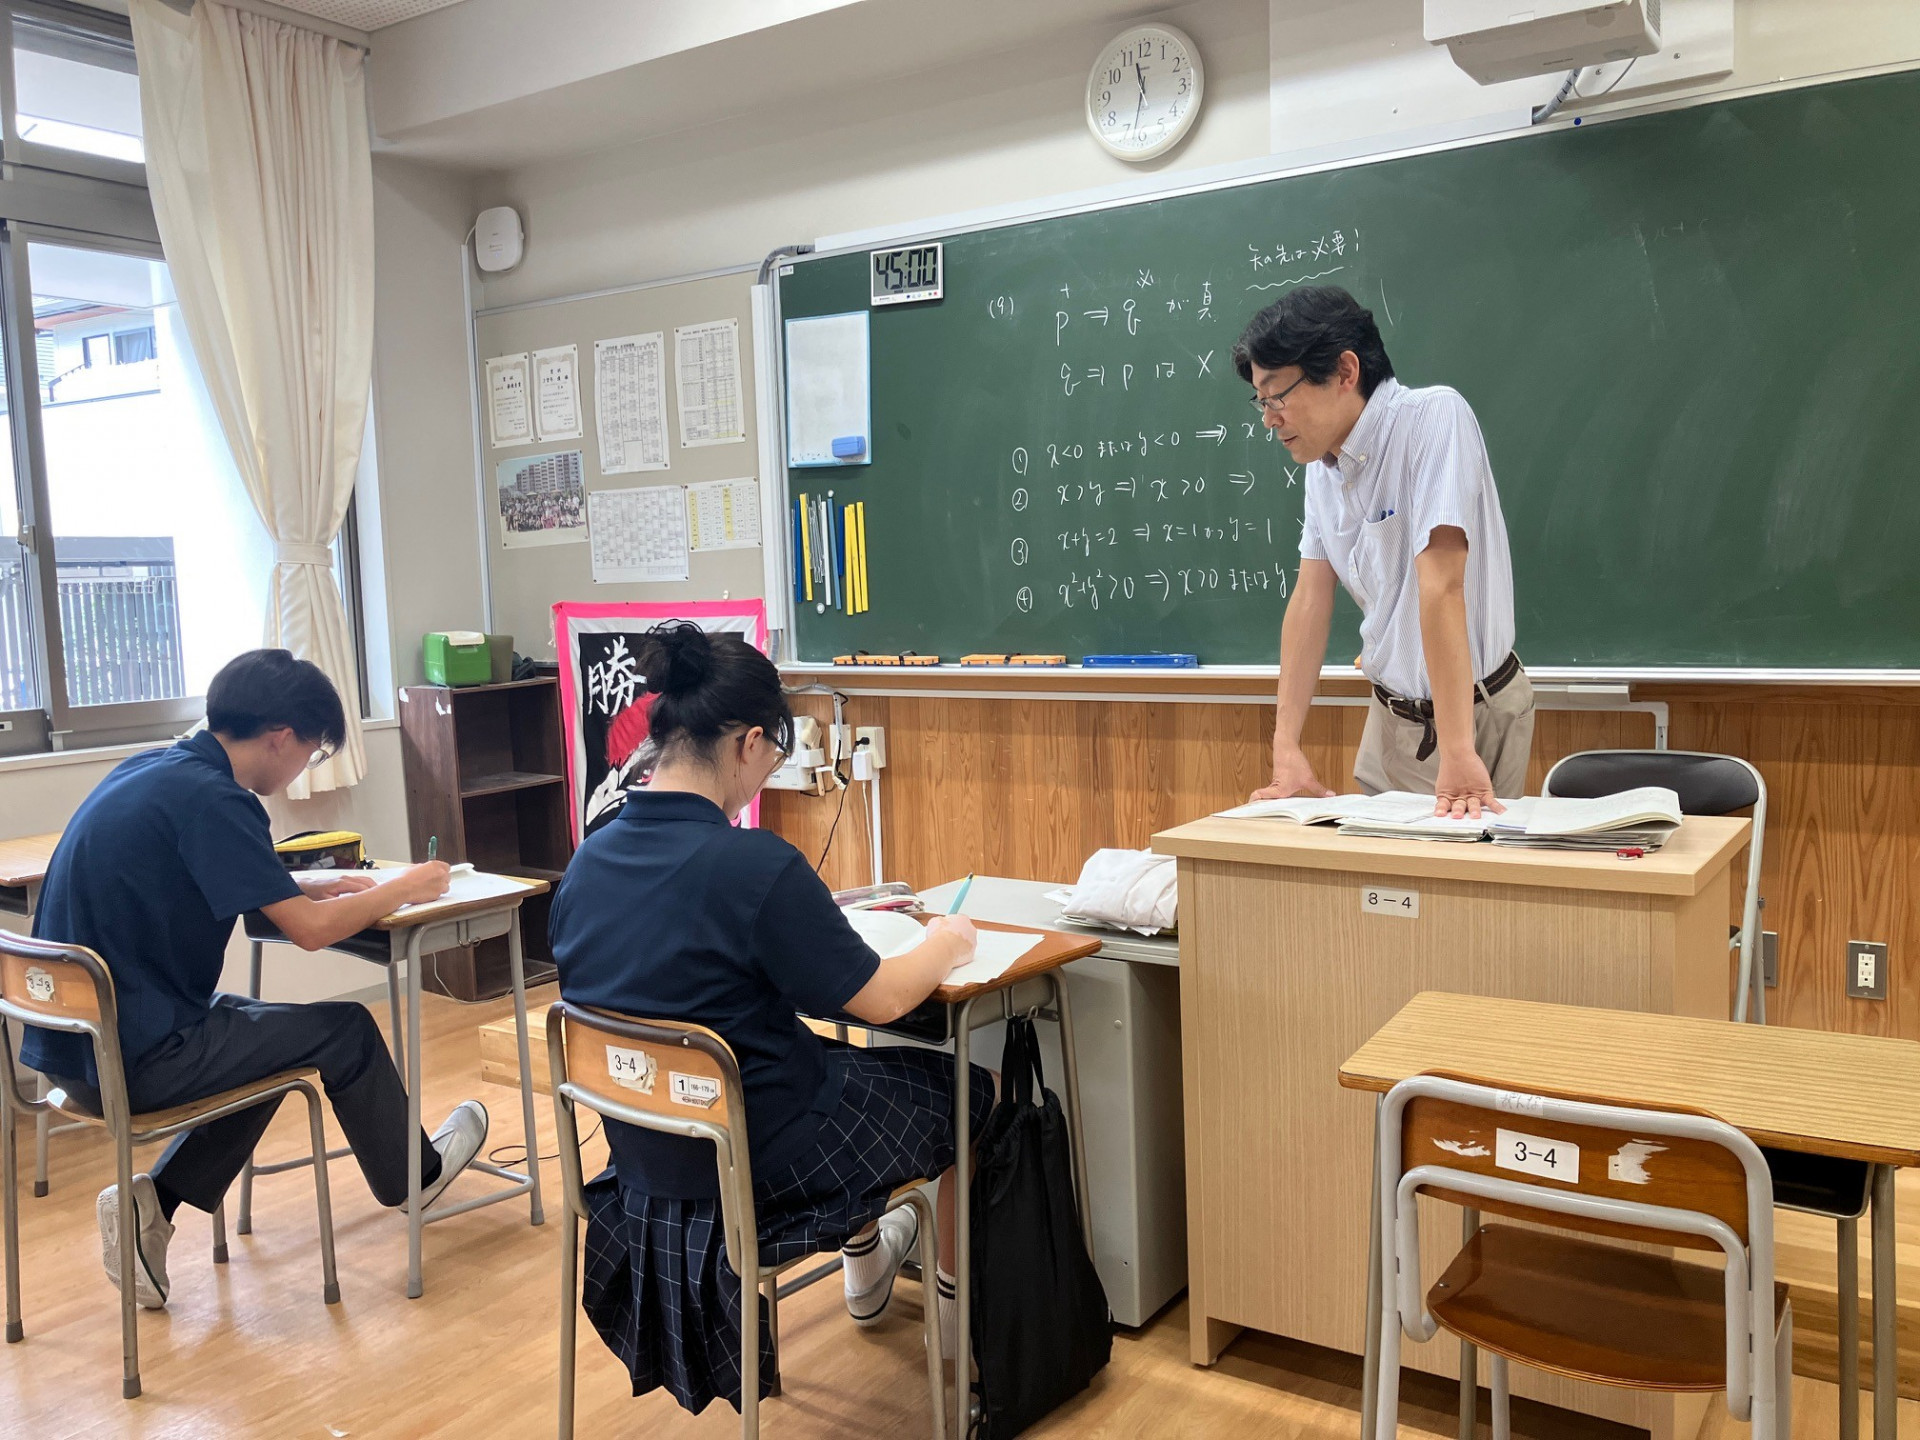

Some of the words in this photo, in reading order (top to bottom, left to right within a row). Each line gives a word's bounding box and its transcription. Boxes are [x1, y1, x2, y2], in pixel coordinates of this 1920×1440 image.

[1138, 41, 1151, 58] 12
[1122, 50, 1133, 67] 11
[1172, 56, 1181, 73] 2
[1108, 68, 1121, 85] 10
[1178, 77, 1187, 95] 3
[1102, 90, 1111, 108] 9
[1169, 100, 1177, 117] 4
[1107, 111, 1116, 126] 8
[1157, 117, 1164, 134] 5
[1123, 123, 1131, 140] 7
[875, 247, 937, 290] 45:00
[587, 635, 648, 717] 勝
[614, 1054, 637, 1073] 3-4
[678, 1079, 685, 1091] 1
[1514, 1141, 1558, 1169] 3-4
